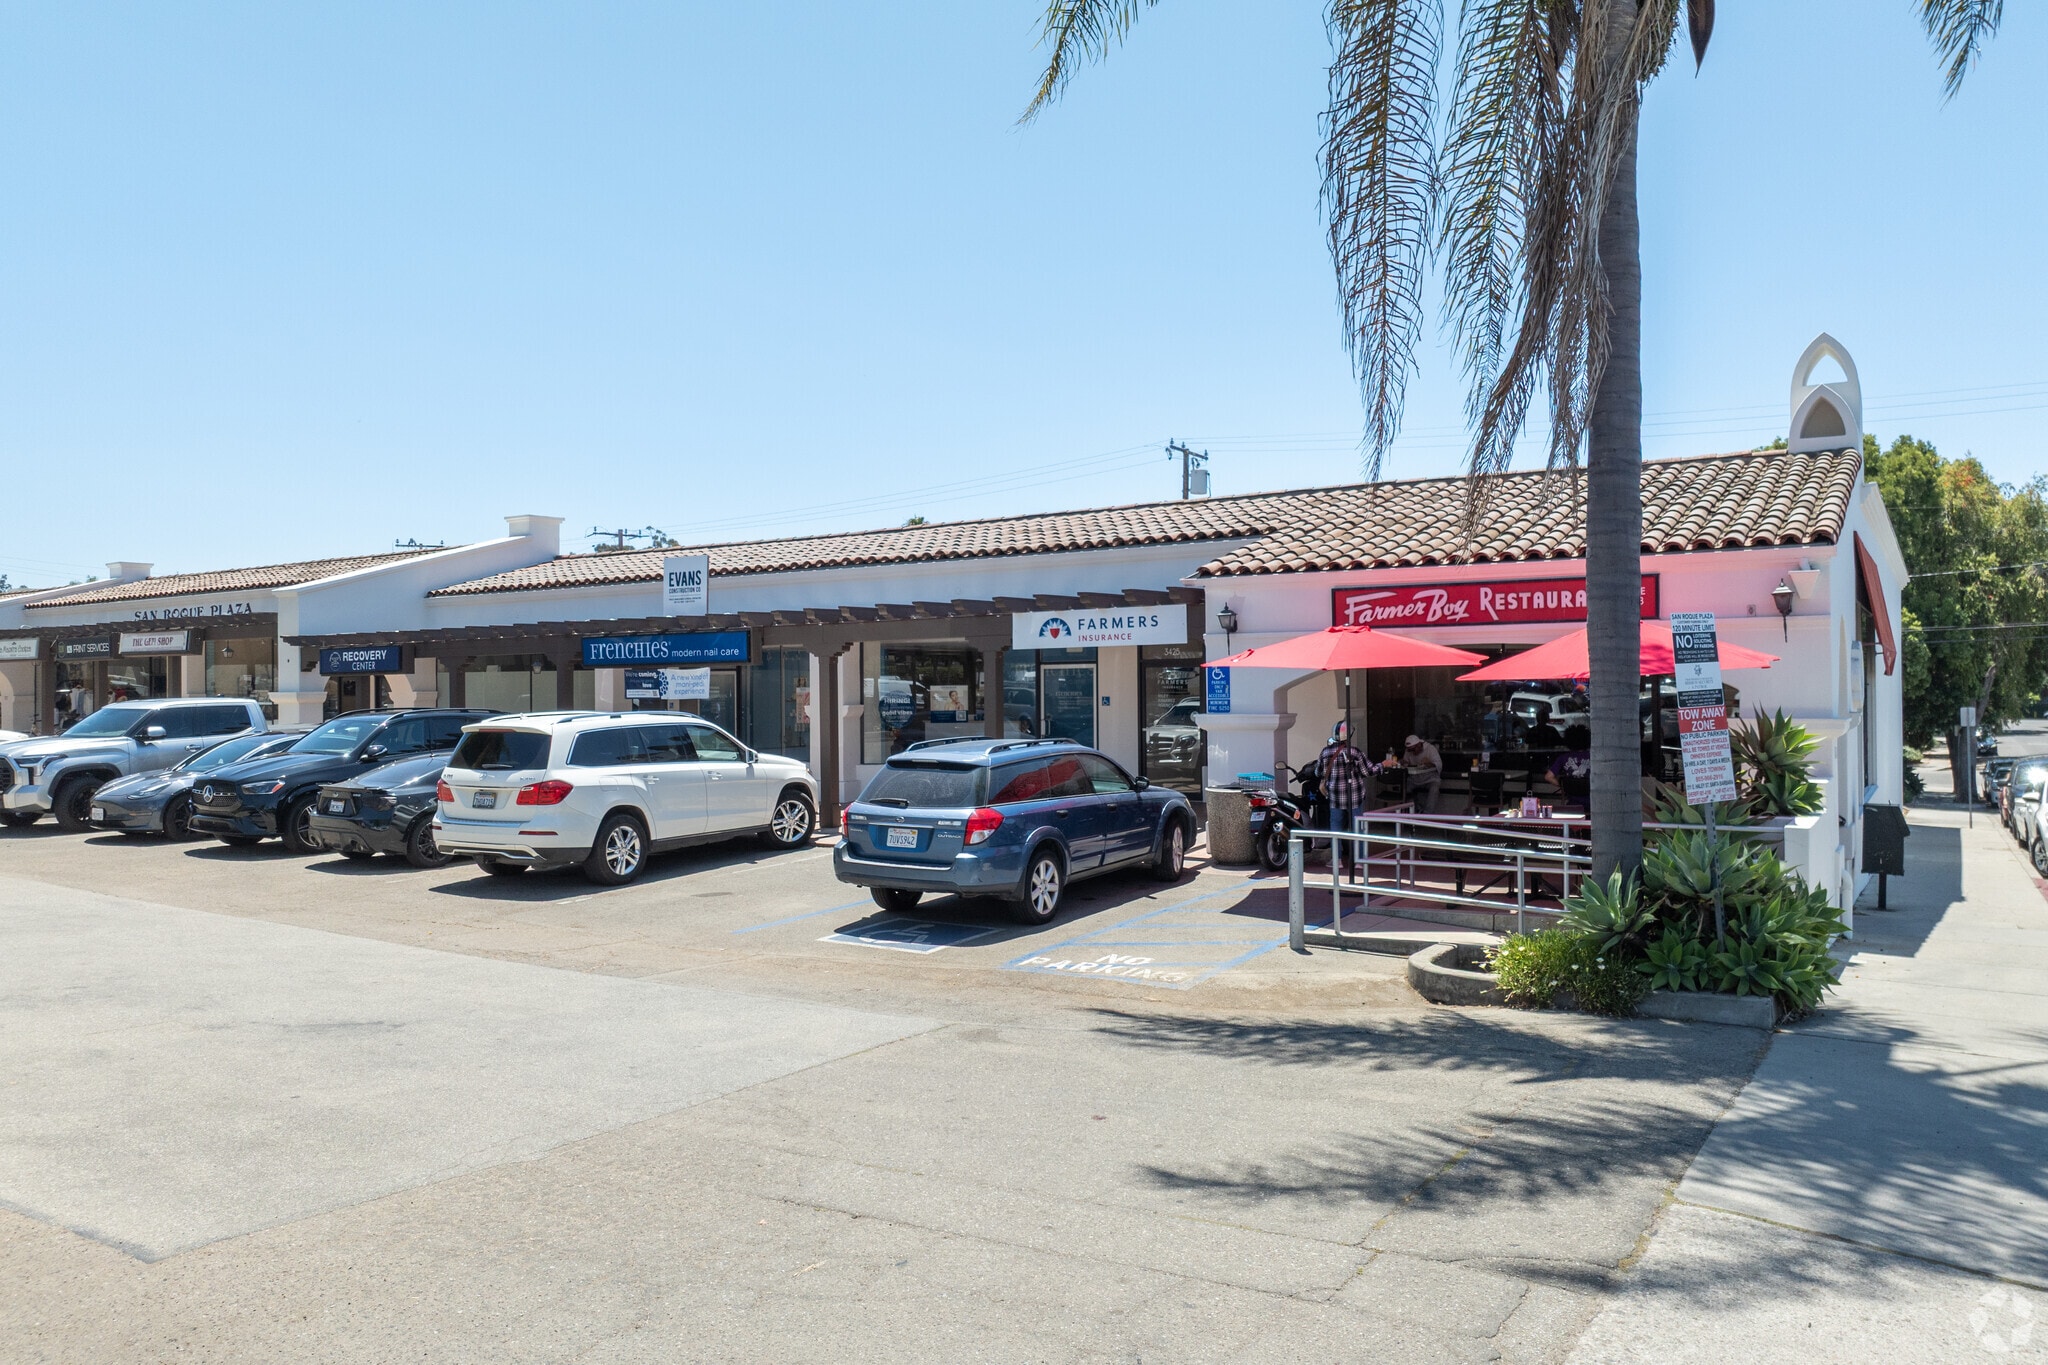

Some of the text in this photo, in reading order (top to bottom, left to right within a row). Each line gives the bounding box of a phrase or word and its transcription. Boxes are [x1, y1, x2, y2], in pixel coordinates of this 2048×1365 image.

[669, 570, 702, 587] EVANS
[134, 602, 252, 621] SAN ROQUE PLAZA
[1344, 587, 1588, 625] Farmer Boy RESTAURA
[1078, 615, 1159, 630] FARMERS
[158, 636, 174, 646] SHOP
[1078, 633, 1132, 642] INSURANCE
[1676, 635, 1693, 648] NO
[73, 644, 86, 652] PRINT
[87, 643, 110, 652] SERVICES
[672, 650, 702, 658] modern
[704, 648, 718, 656] nail
[342, 650, 387, 662] RECOVERY
[352, 662, 376, 670] CENTER
[1679, 707, 1725, 720] TOW AWAY
[1692, 720, 1716, 731] ZONE
[889, 835, 915, 846] 7UVS942
